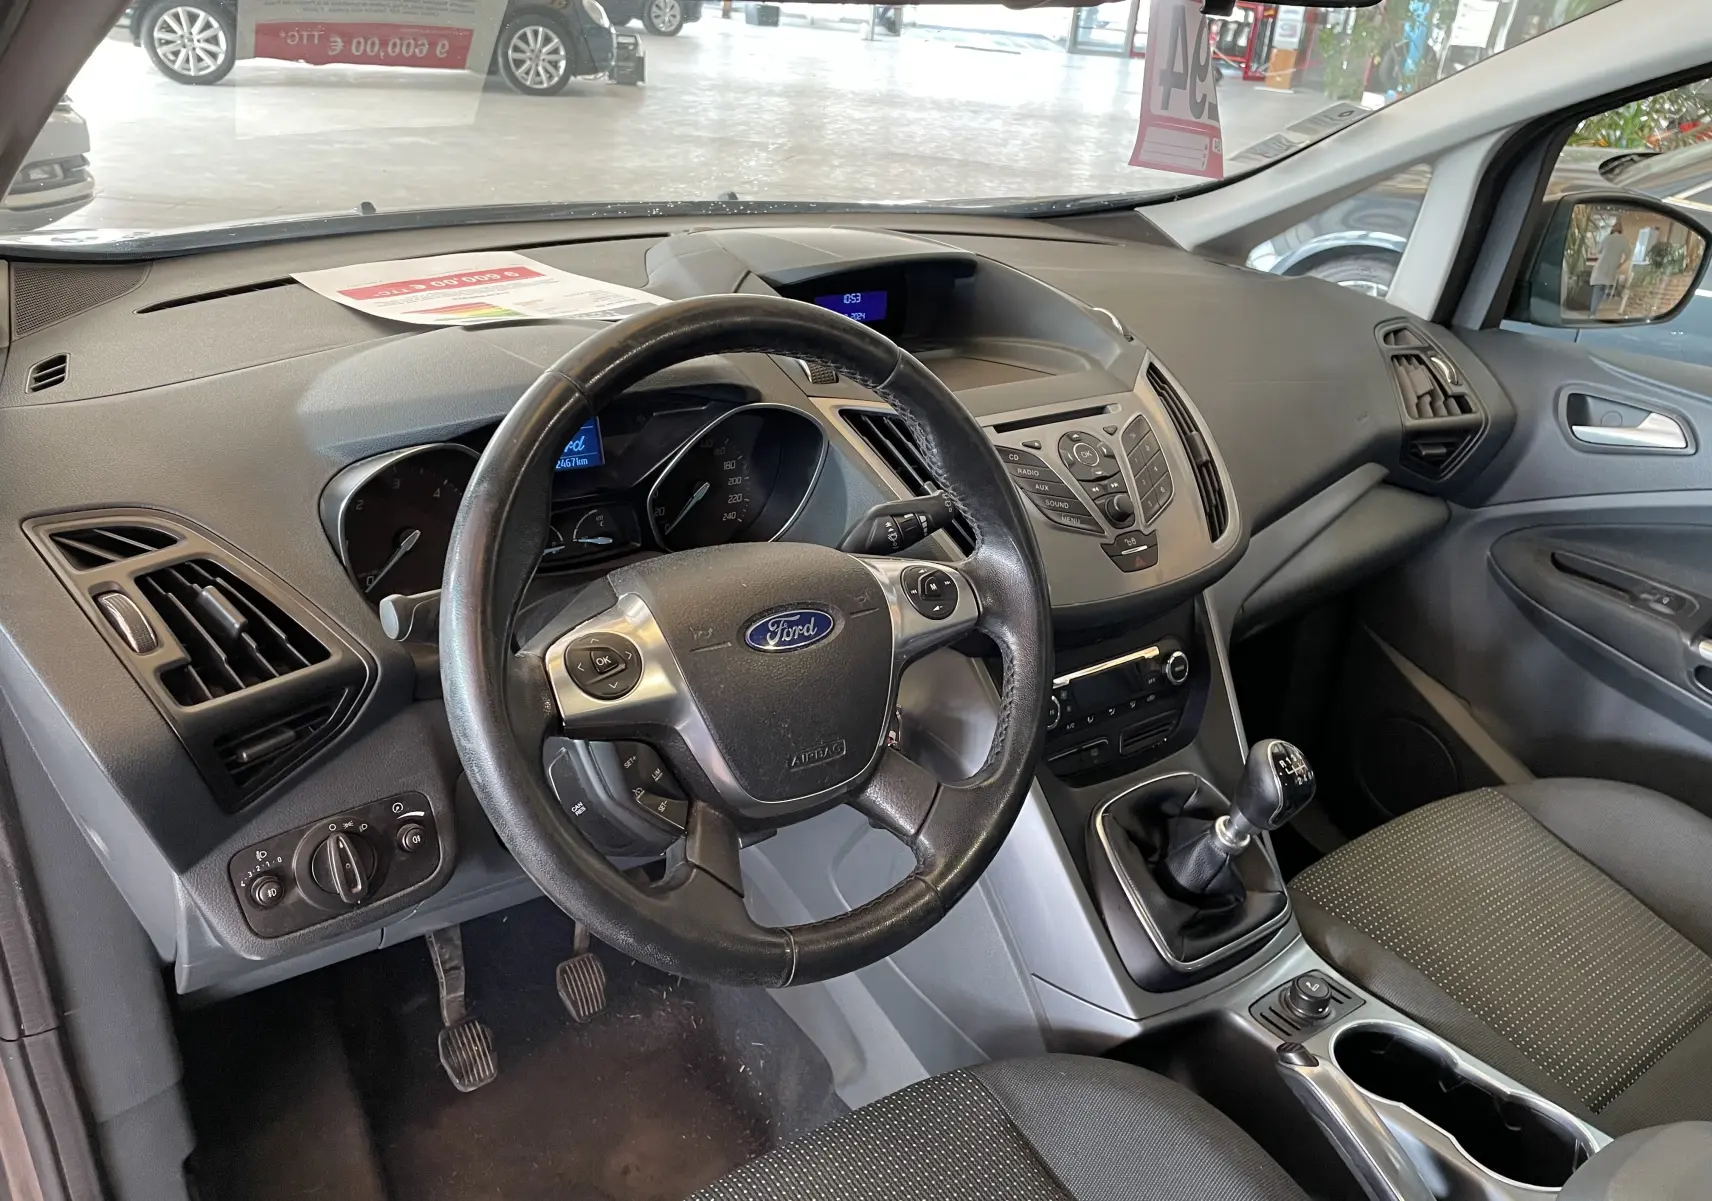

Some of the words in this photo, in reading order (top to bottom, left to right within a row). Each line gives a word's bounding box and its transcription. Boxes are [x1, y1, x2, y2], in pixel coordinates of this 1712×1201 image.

[563, 435, 586, 453] rd
[1008, 453, 1019, 461] CD
[1080, 450, 1093, 458] OK
[723, 460, 736, 470] 180
[1017, 468, 1040, 477] RADIO
[393, 478, 400, 489] 3
[728, 476, 742, 485] 200
[433, 487, 441, 498] 4
[727, 493, 743, 504] 220
[355, 499, 364, 511] 2
[1045, 500, 1069, 509] SOUND
[722, 511, 737, 521] 240
[366, 575, 375, 586] 0
[766, 614, 818, 646] Ford
[595, 654, 612, 668] OK
[790, 743, 843, 768] AIRBAG
[651, 767, 661, 779] LIM
[571, 801, 584, 813] CAN
